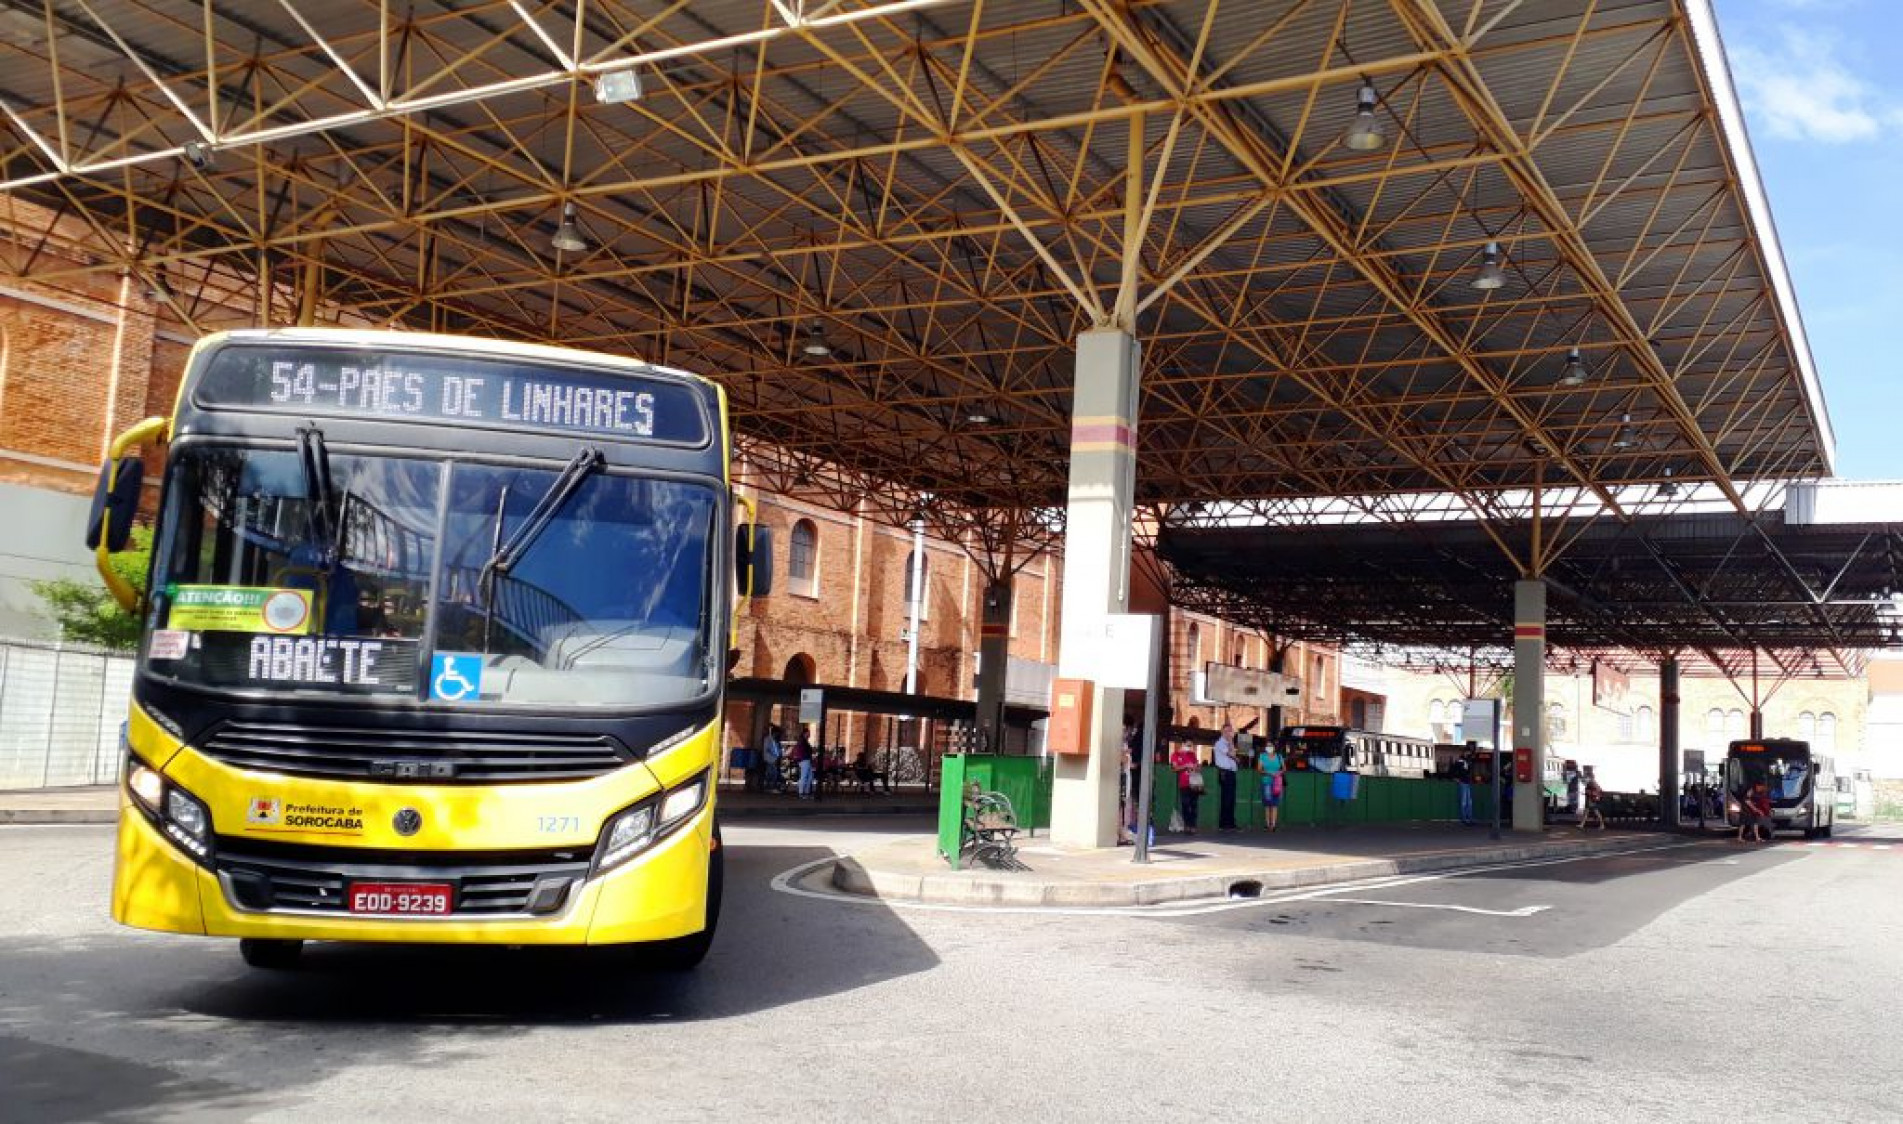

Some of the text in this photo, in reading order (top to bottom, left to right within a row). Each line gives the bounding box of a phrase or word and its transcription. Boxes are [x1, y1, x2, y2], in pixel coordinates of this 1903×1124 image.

[271, 361, 655, 435] 54-PAES DE LINHARES
[248, 635, 382, 685] ABAETE
[286, 804, 363, 816] Prefeitura de
[285, 815, 363, 829] SOROCABA
[537, 816, 579, 832] 1271
